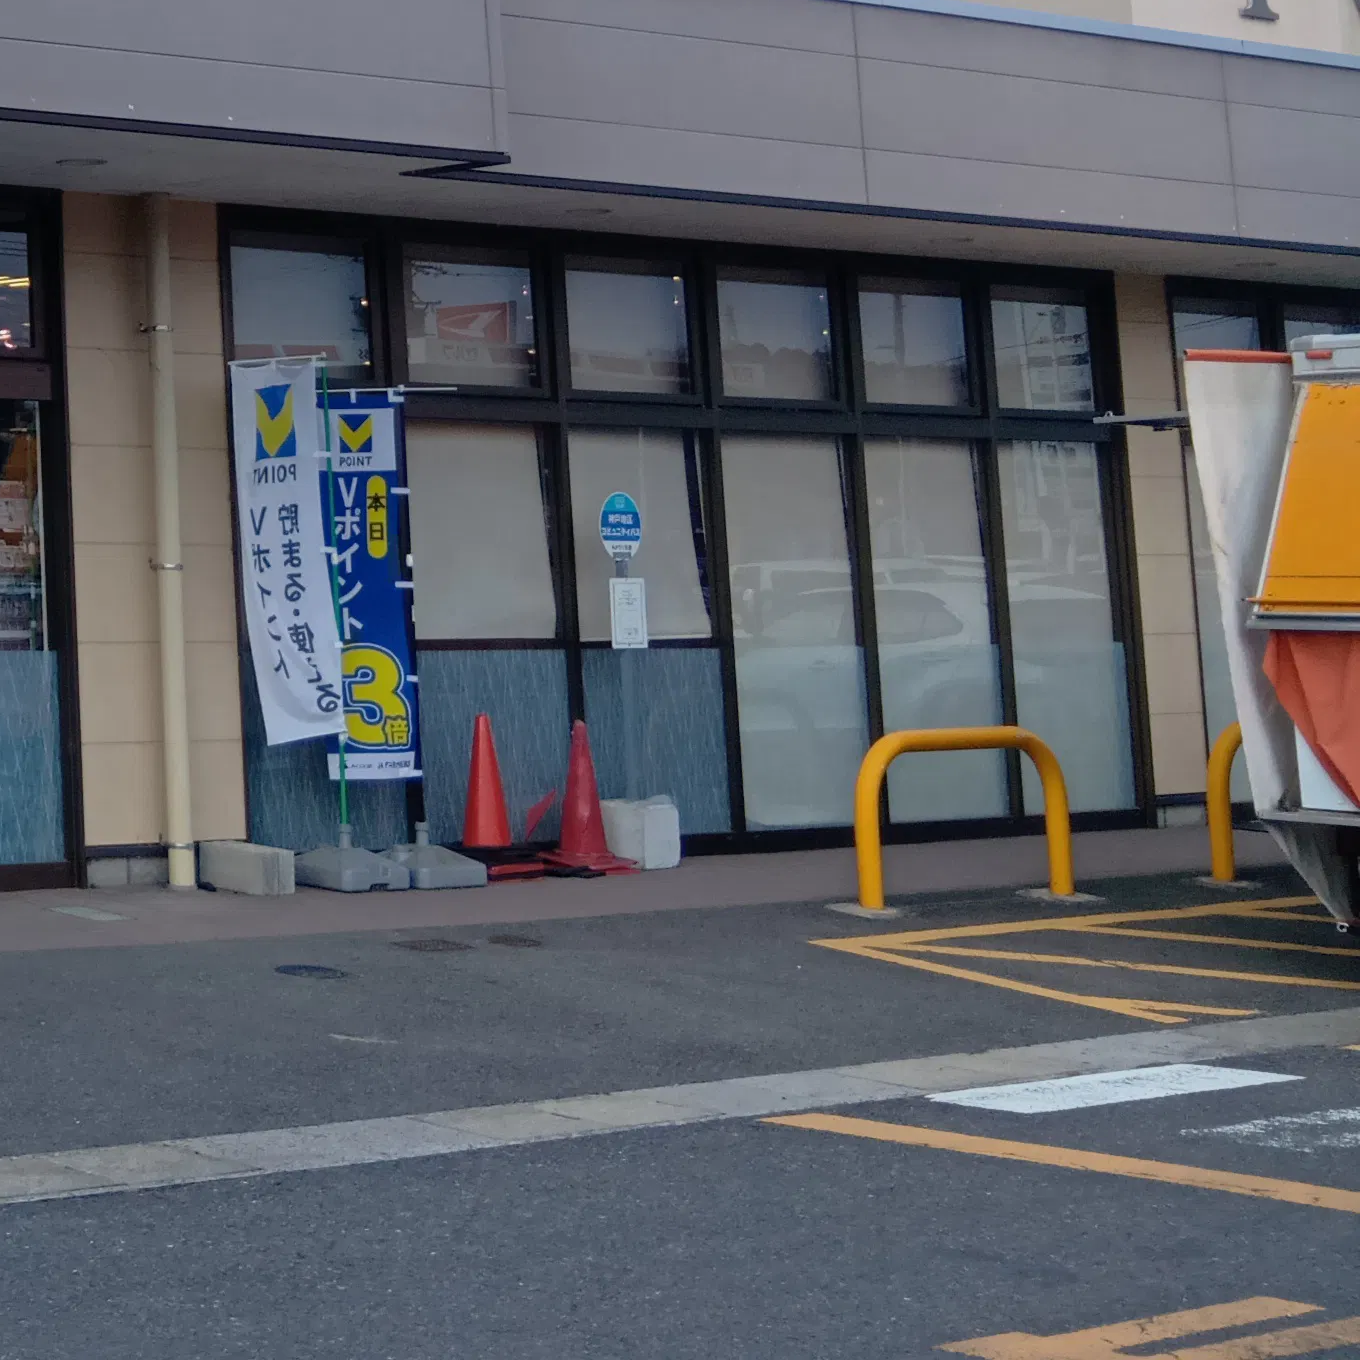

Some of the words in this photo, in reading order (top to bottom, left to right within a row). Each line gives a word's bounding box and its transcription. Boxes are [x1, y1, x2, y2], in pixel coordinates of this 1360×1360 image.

[339, 455, 372, 467] POINT
[367, 493, 386, 542] 本日
[334, 476, 364, 641] Vポイント
